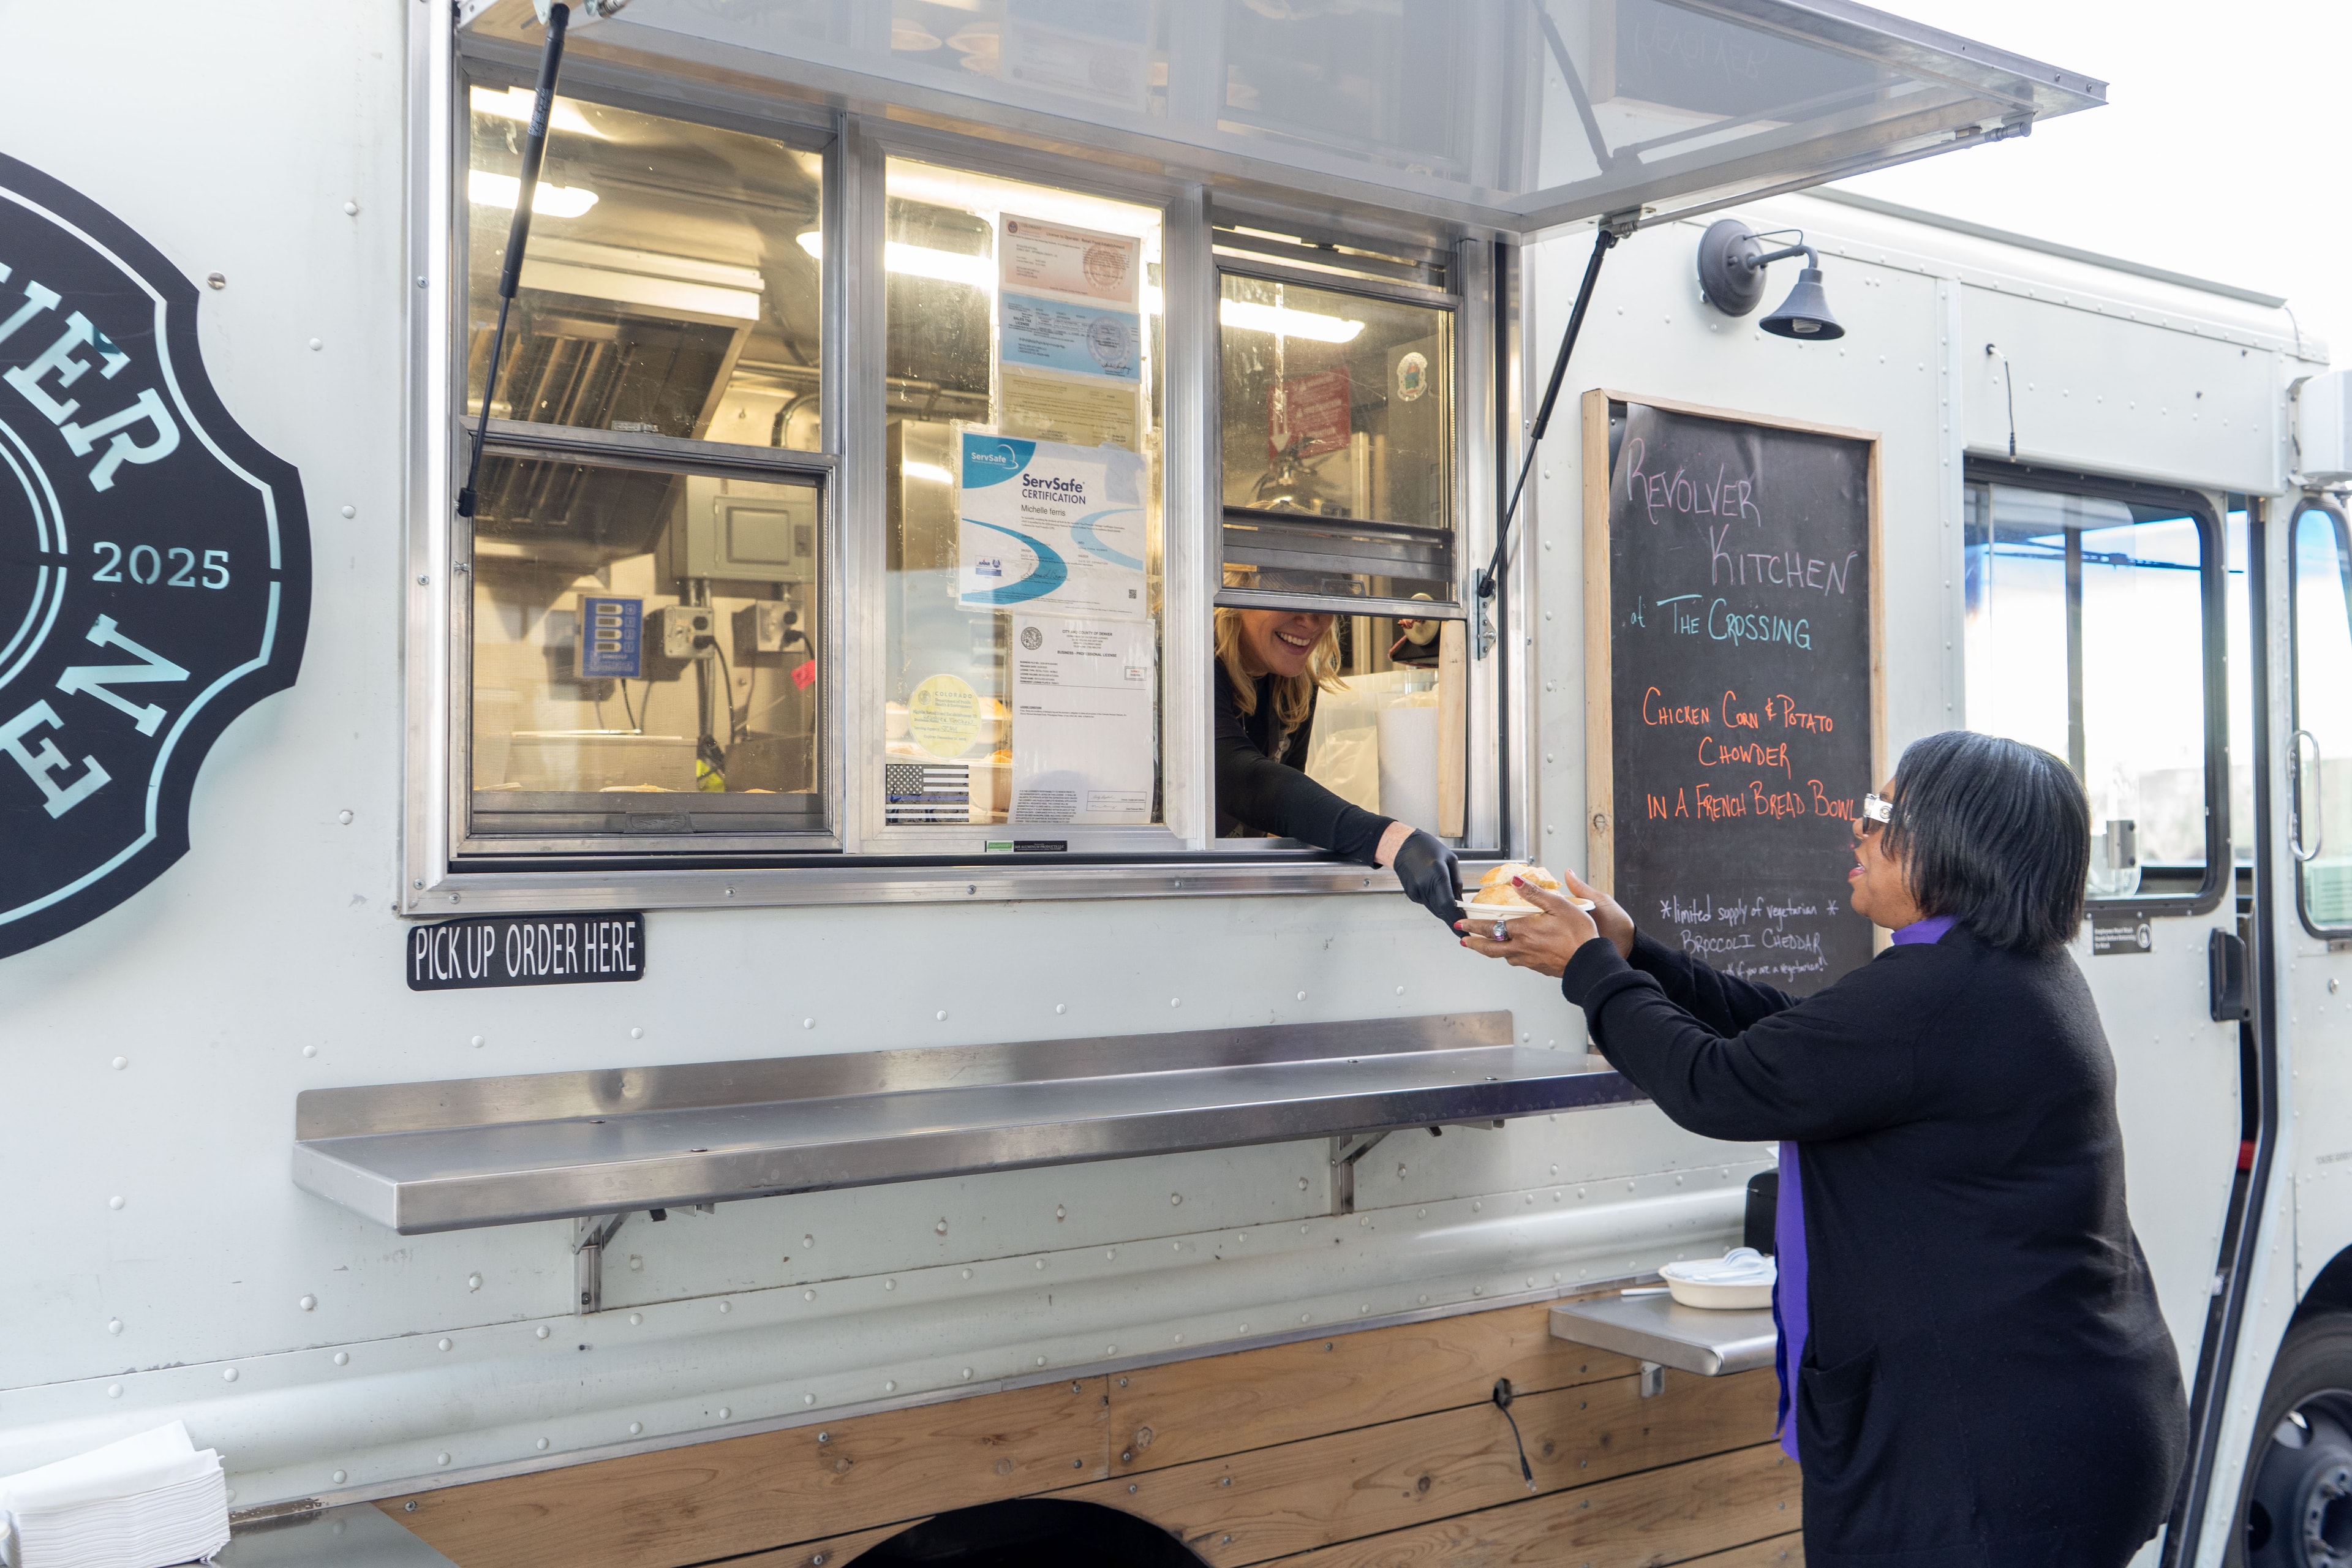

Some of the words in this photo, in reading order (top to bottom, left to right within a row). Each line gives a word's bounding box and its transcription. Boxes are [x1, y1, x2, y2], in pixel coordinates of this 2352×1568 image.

[971, 451, 1006, 463] ServSafe
[1021, 504, 1048, 514] Michelle
[1049, 507, 1066, 516] ferris
[1022, 489, 1086, 505] CERTIFICATION
[92, 541, 230, 589] 2025
[1710, 524, 1858, 597] KITCHEN
[1630, 596, 1645, 628] at
[1656, 594, 1702, 635] THE
[1708, 598, 1812, 650] CROSSING
[1643, 687, 1710, 725] CHICKEN
[1722, 690, 1758, 729] CORN
[1777, 694, 1833, 734] POTATO
[1698, 736, 1792, 780] CHOWDER
[1647, 794, 1667, 820] IN
[1675, 787, 1689, 818] A
[1695, 783, 1746, 822] FRENCH
[1749, 780, 1805, 820] BREAD
[1807, 779, 1858, 821] BOWL
[1673, 894, 1711, 924] limited
[1717, 899, 1747, 927] supply
[1751, 897, 1764, 918] of
[1766, 898, 1817, 932] vegetarian
[416, 926, 462, 981] PICK
[467, 925, 496, 979] UP
[506, 922, 578, 978] ORDER
[585, 921, 636, 973] HERE
[1681, 930, 1756, 959] BROCCOLI
[1762, 928, 1828, 966] CHEDDAR
